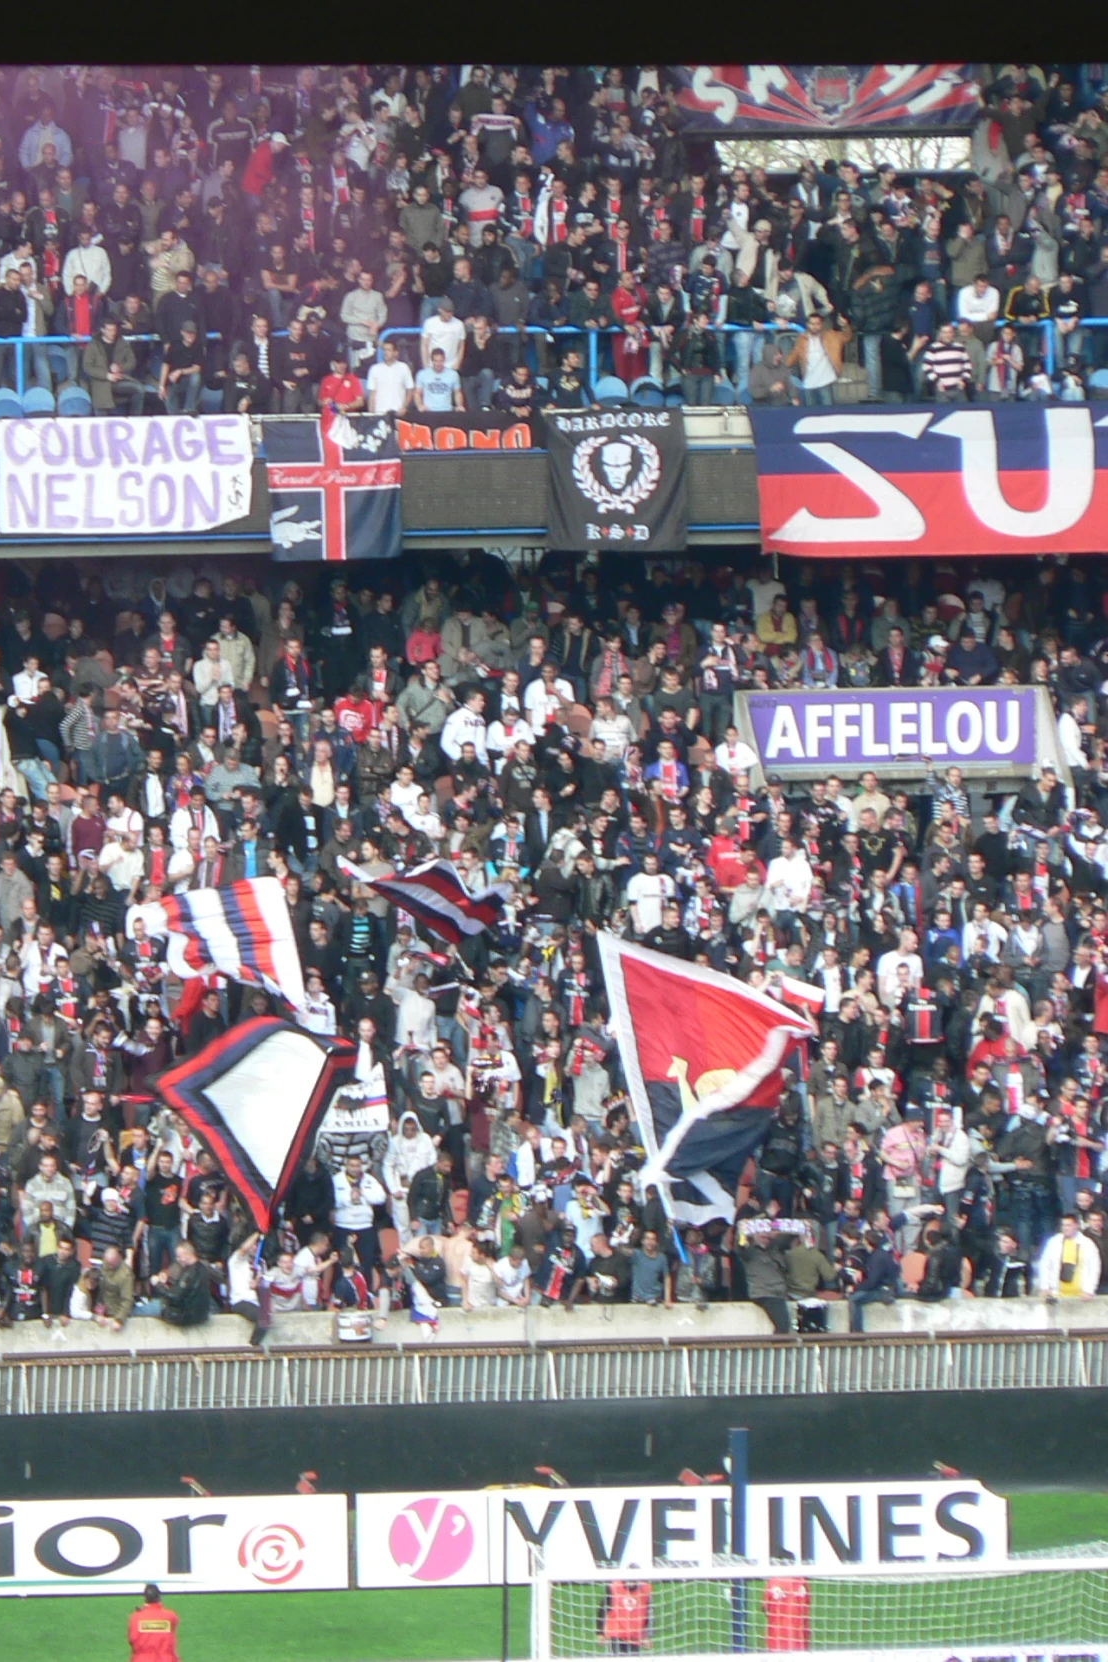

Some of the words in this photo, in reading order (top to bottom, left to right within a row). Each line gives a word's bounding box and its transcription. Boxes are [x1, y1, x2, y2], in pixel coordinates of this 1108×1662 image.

[4, 418, 244, 468] COURAGE
[394, 418, 532, 451] MONO
[556, 411, 672, 433] HARDCORE
[6, 470, 222, 529] NELSON
[768, 406, 1108, 544] SU
[765, 699, 1020, 759] AFFLELOU
[505, 1490, 987, 1577] YVELINES
